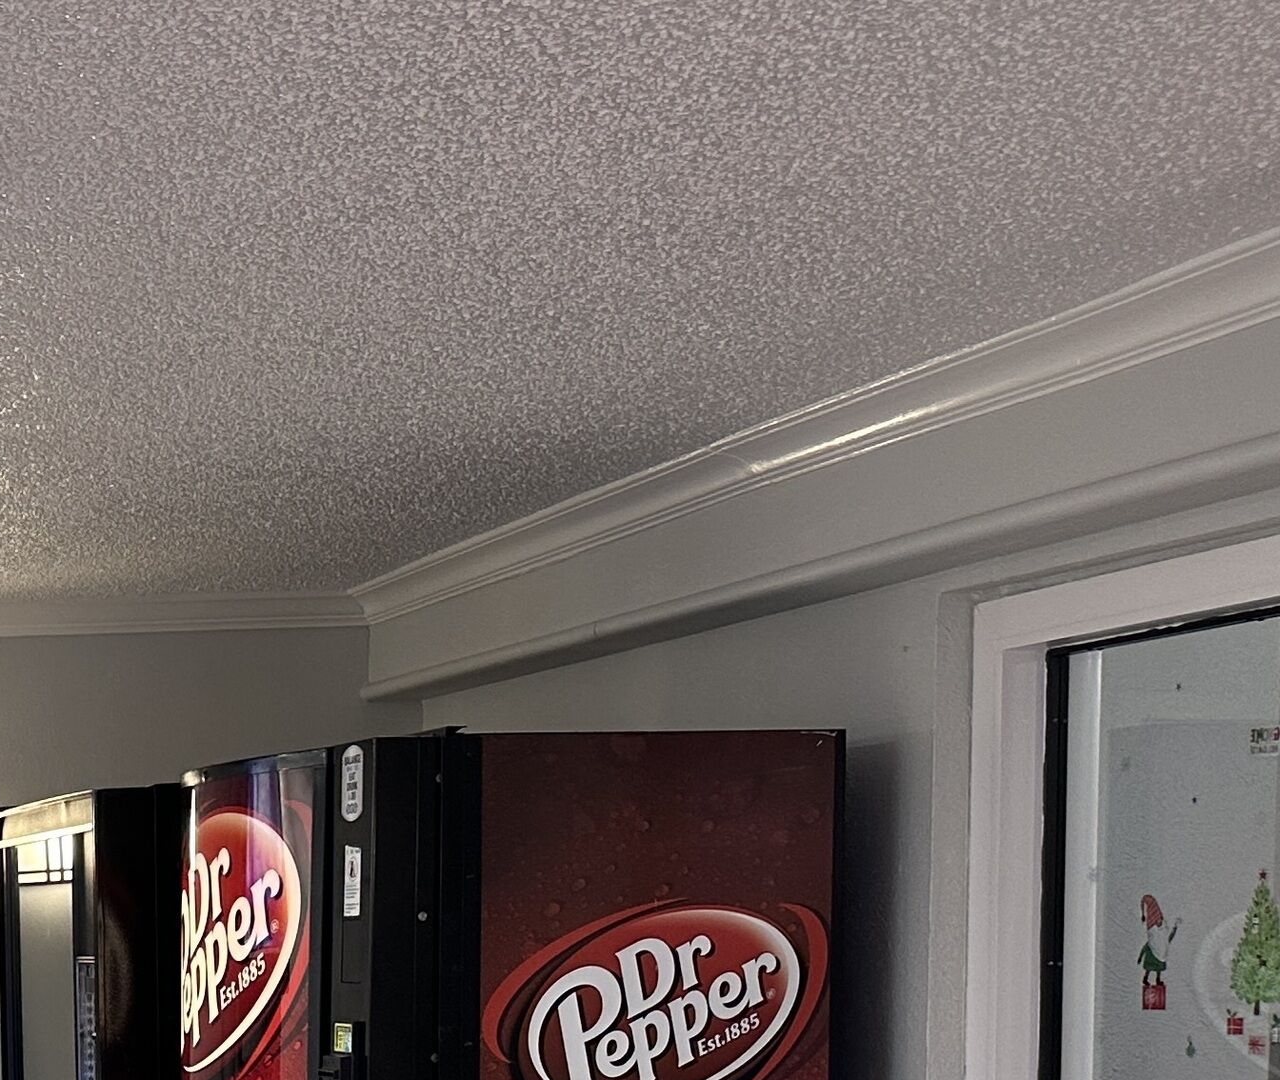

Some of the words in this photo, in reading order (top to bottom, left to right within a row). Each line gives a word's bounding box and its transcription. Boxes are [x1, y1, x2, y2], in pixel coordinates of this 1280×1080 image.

[188, 847, 231, 959] Dr
[219, 953, 267, 1011] Est.1885
[615, 935, 712, 1020] Dr
[696, 1012, 761, 1057] Est.1885
